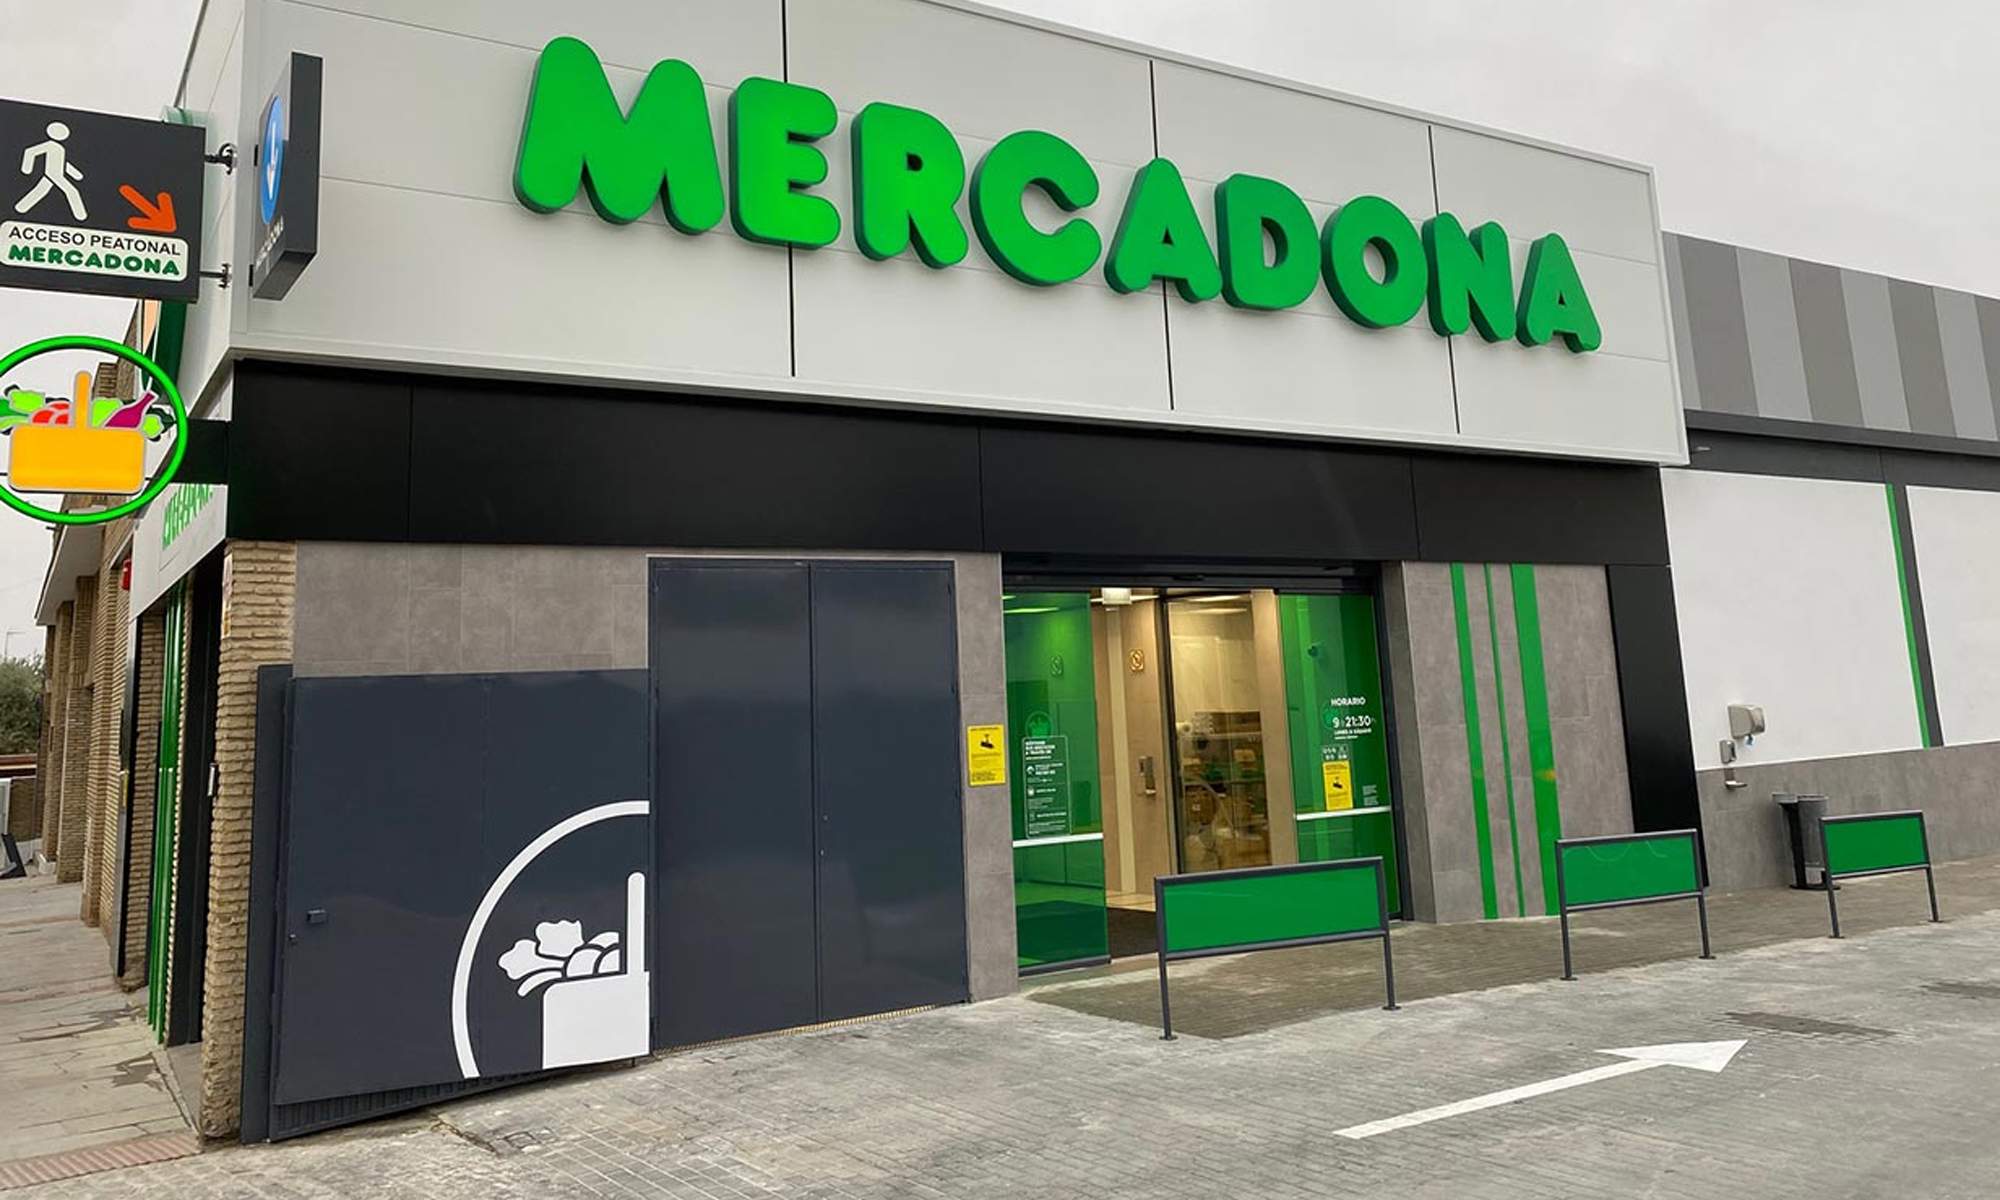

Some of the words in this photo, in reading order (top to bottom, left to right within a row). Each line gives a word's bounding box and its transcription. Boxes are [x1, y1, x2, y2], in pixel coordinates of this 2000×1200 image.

[513, 36, 1602, 354] MERCADONA
[8, 226, 85, 246] ACCESO
[90, 234, 181, 256] PEATONAL
[8, 244, 180, 275] MERCADONA
[1330, 696, 1366, 706] HORARIO
